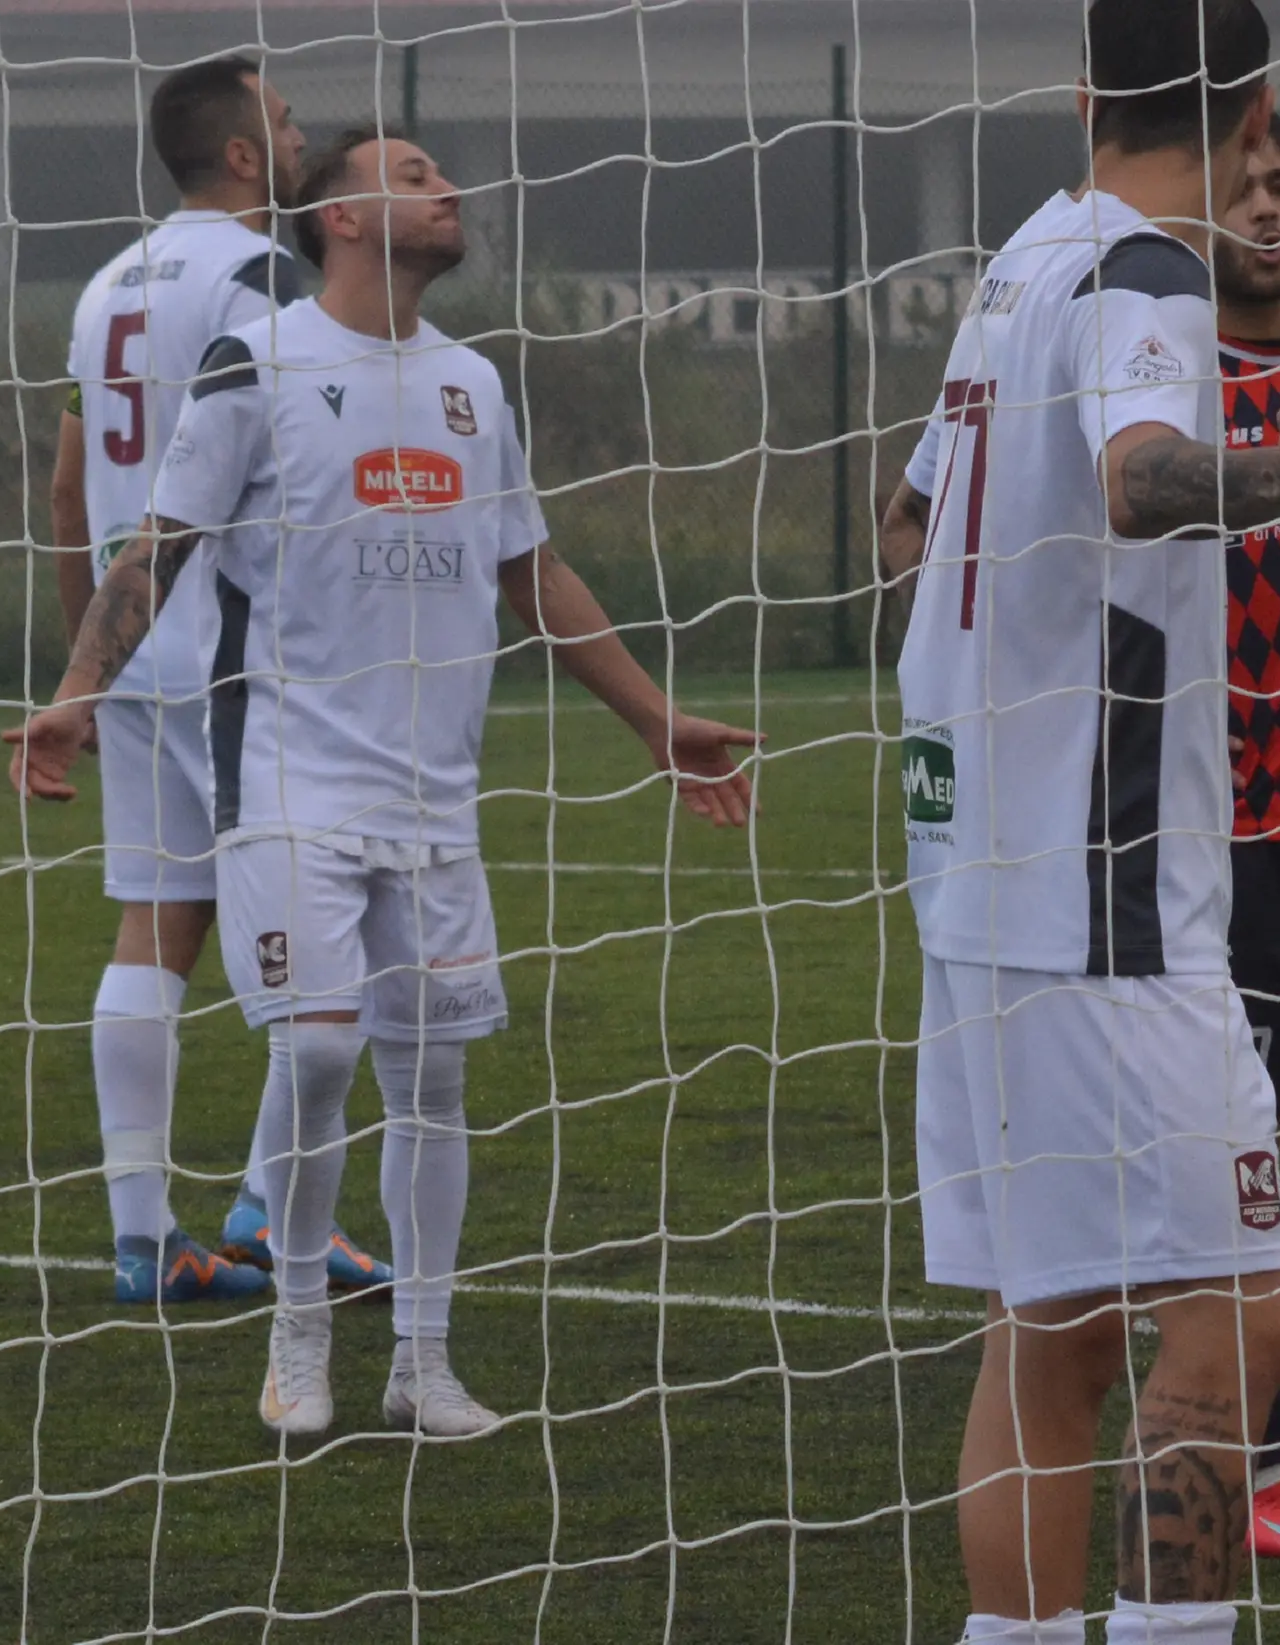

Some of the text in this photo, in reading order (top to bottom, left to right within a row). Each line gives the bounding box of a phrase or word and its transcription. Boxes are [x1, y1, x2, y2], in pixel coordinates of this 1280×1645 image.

[103, 310, 149, 467] 5
[365, 469, 453, 492] MICELI
[358, 544, 465, 578] L'OASI
